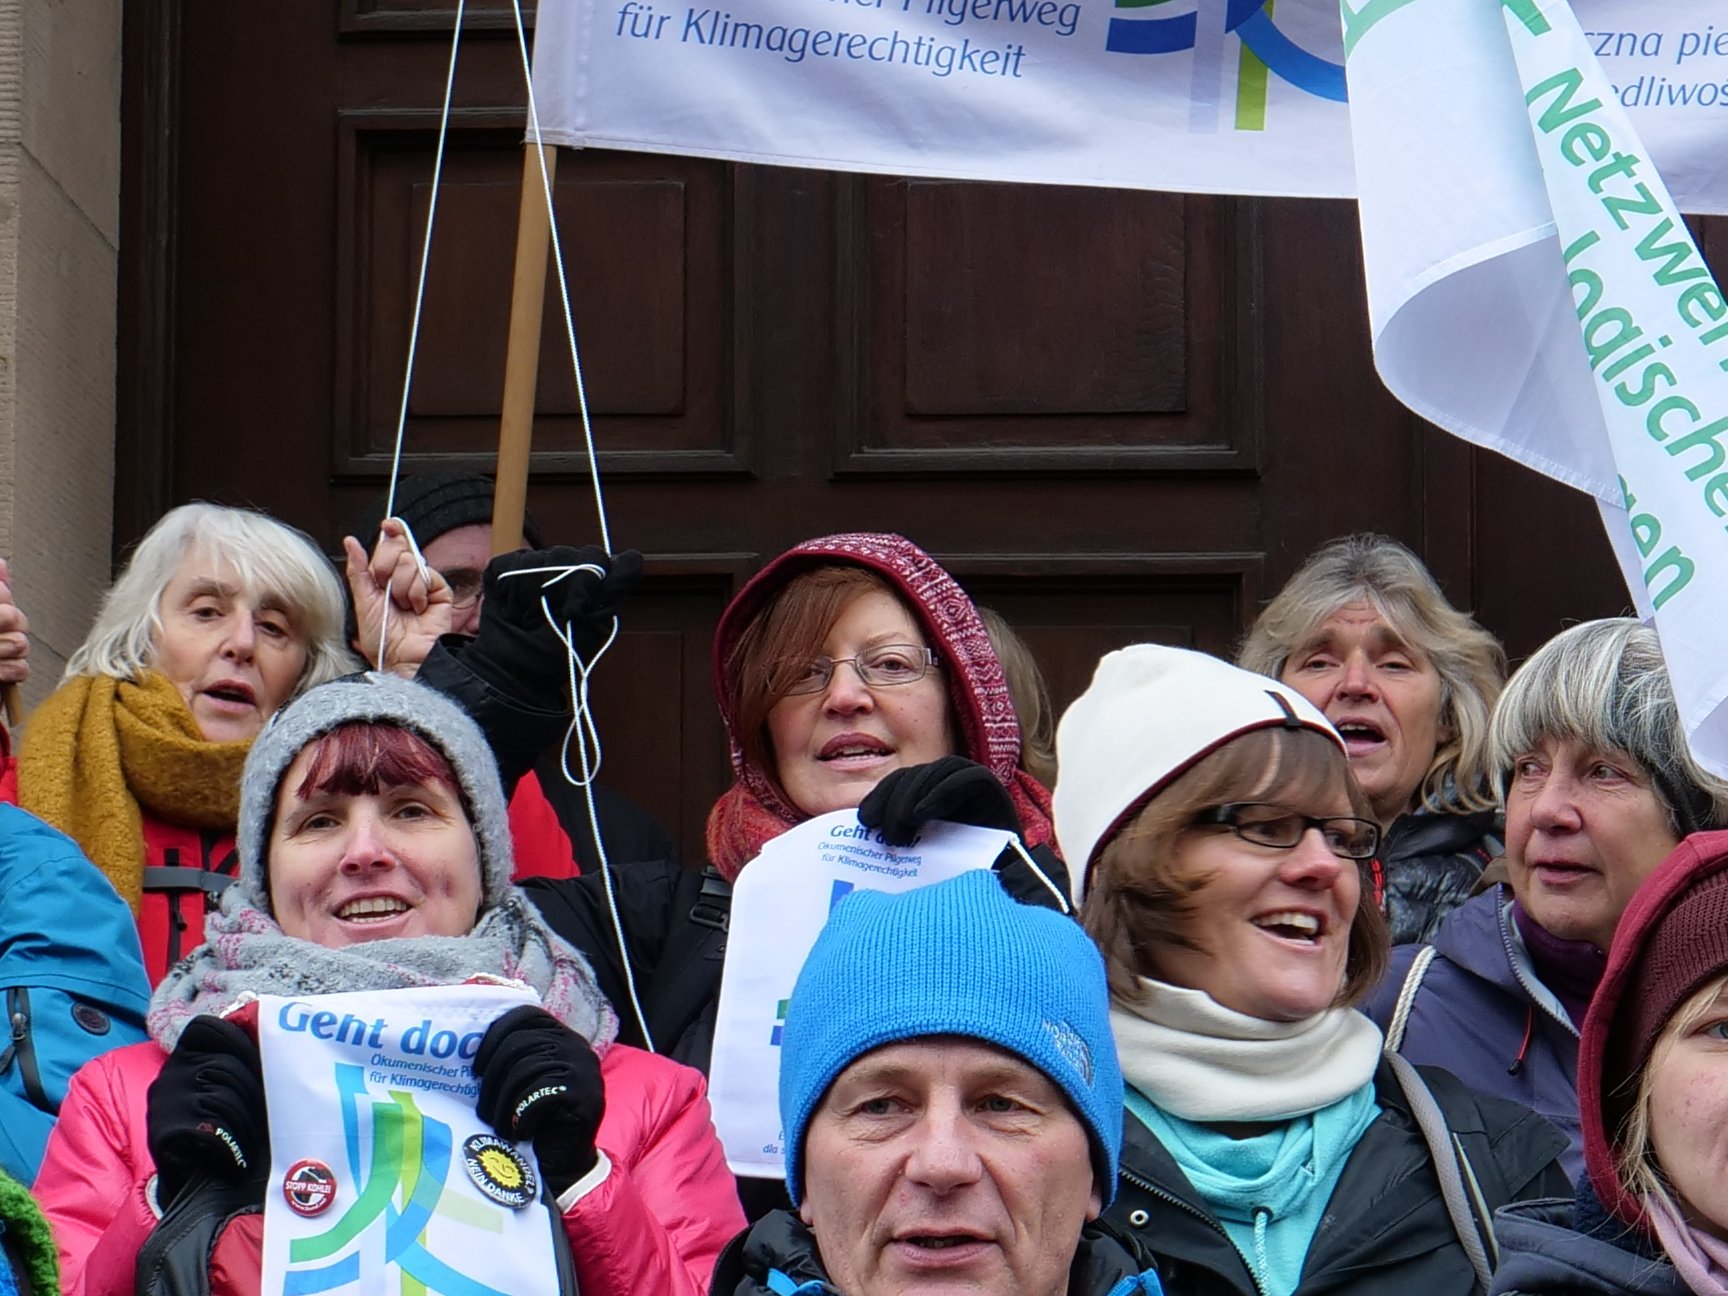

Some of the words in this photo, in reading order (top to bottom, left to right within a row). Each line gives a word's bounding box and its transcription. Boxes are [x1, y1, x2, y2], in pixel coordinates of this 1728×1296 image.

[615, 2, 671, 40] für
[682, 7, 1026, 79] Klimagerechtigkeit
[837, 855, 918, 879] Klimagerechtigkeit
[370, 1071, 386, 1084] für
[371, 1053, 458, 1079] Ökumenischer
[516, 1087, 559, 1117] POLARTEC
[467, 1158, 488, 1185] NEIN
[487, 1182, 524, 1203] DANKE
